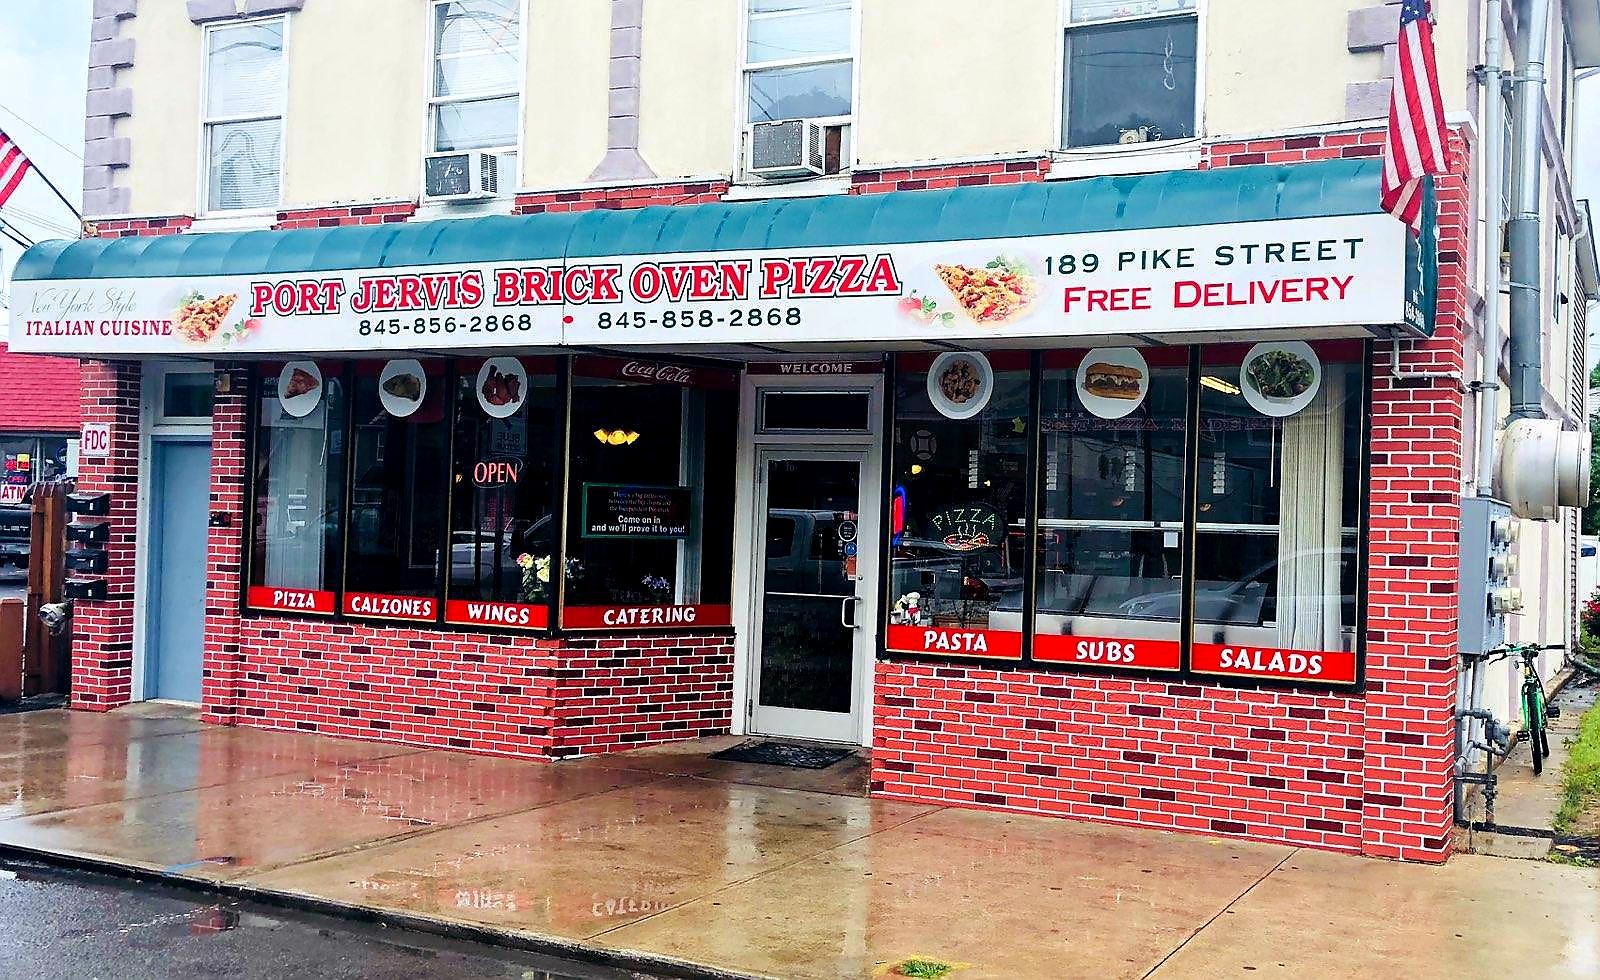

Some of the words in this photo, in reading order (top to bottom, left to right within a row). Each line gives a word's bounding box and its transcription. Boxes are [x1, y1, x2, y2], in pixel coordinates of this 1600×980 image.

[1045, 253, 1099, 275] 189
[1118, 247, 1195, 271] PIKE
[1214, 238, 1364, 266] STREET
[250, 278, 346, 317] PORT
[350, 270, 485, 313] JERVIS
[493, 264, 622, 306] BRICK
[629, 259, 752, 303] OVEN
[760, 254, 903, 299] PIZZA
[1063, 286, 1151, 313] FREE
[1173, 275, 1354, 309] DELIVERY
[53, 287, 96, 321] York
[99, 287, 137, 320] Style
[26, 320, 95, 336] ITALIAN
[100, 319, 173, 336] CUISINE
[359, 313, 532, 336] 845-856-2868
[597, 307, 802, 329] 845-858-2868
[780, 363, 852, 374] WELCOME
[84, 430, 107, 450] FDC
[474, 462, 518, 483] OPEN
[2, 485, 27, 500] ATM
[591, 524, 607, 532] and
[608, 524, 627, 532] we'll
[628, 525, 650, 534] prove
[652, 525, 658, 533] it
[659, 525, 668, 533] to
[669, 525, 685, 534] you!
[618, 515, 640, 524] Come
[642, 516, 652, 524] on
[653, 515, 661, 524] in
[930, 508, 995, 531] PIZZA
[273, 590, 315, 609] PIZZA
[351, 596, 432, 617] CALZONES
[467, 603, 530, 625] WINGS
[603, 607, 696, 625] CATERING
[923, 630, 988, 652] PASTA
[1075, 641, 1136, 663] SUBS
[1219, 648, 1323, 675] SALADS
